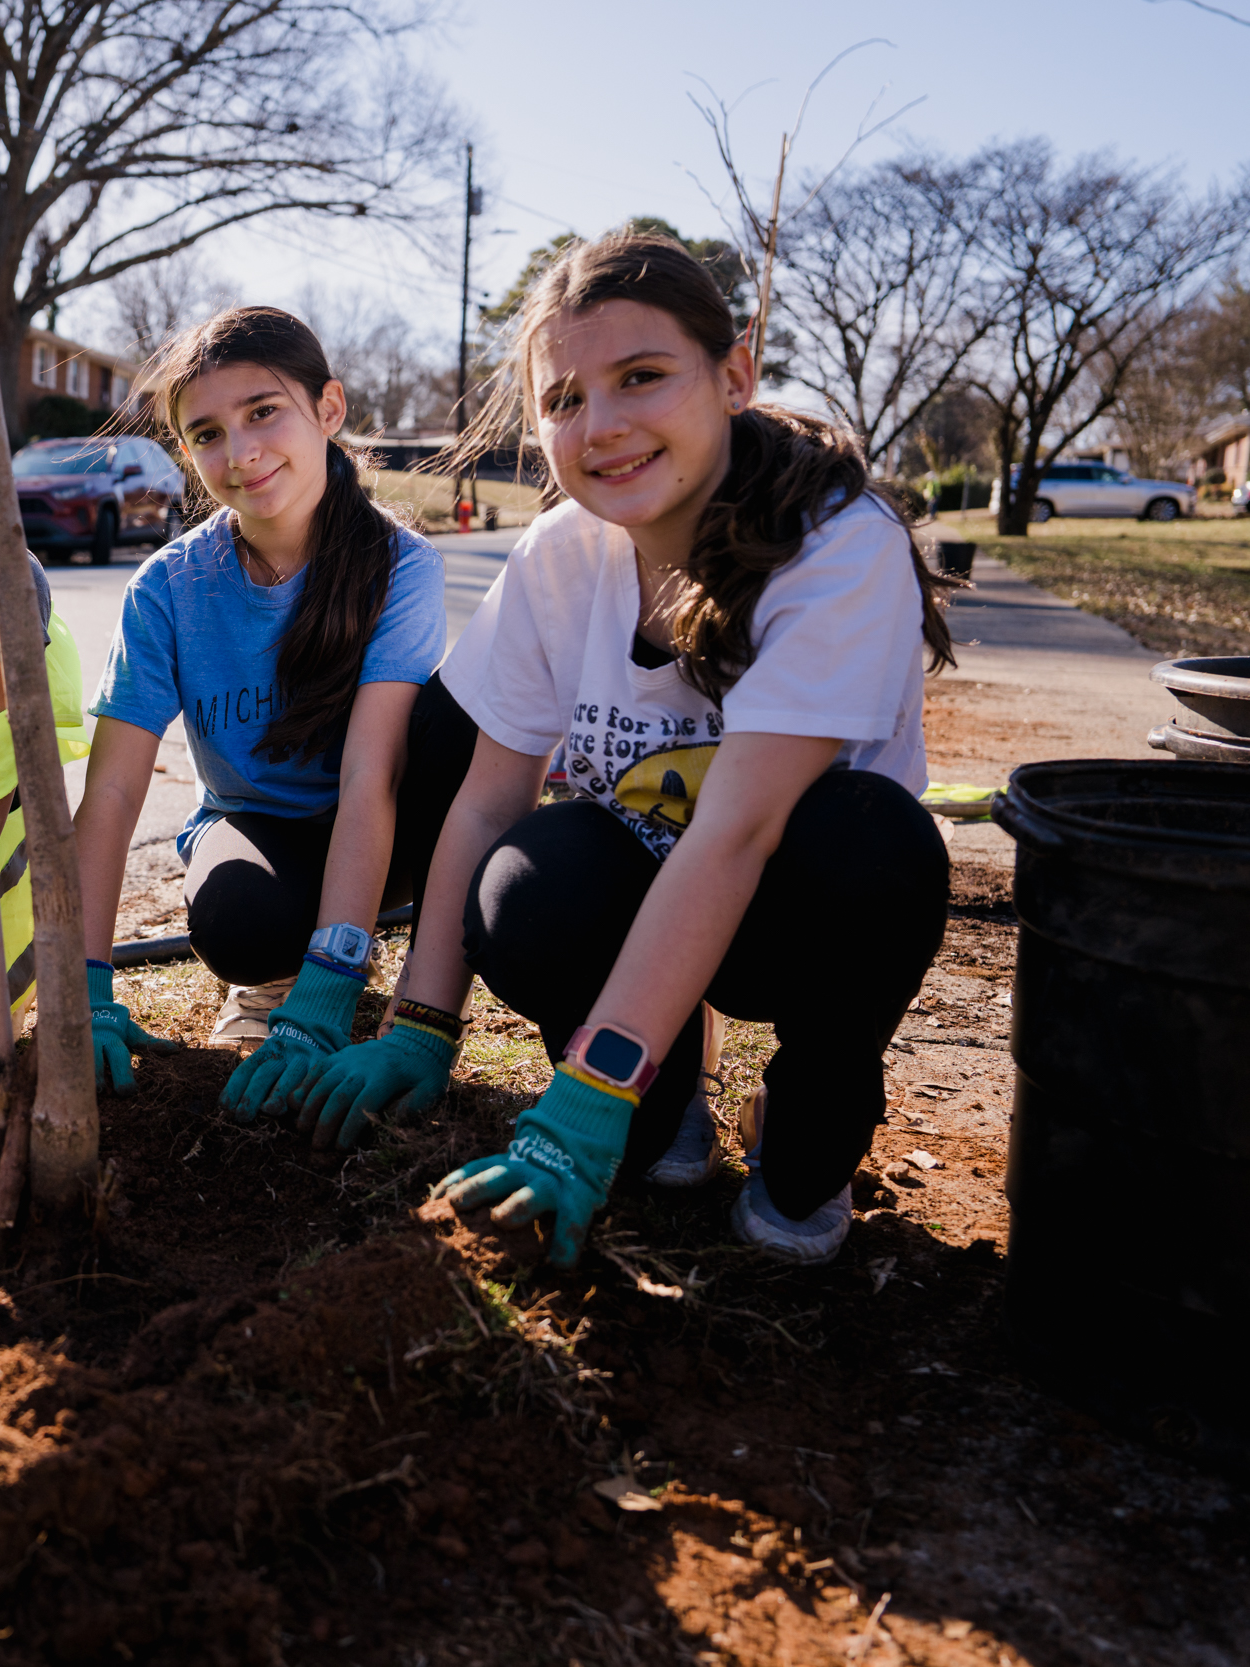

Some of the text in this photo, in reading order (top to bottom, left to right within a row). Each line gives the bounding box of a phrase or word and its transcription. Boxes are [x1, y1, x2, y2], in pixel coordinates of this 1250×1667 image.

[196, 680, 291, 740] MICHI
[607, 706, 650, 735] for
[603, 731, 647, 759] for
[531, 1134, 574, 1170] Quest
